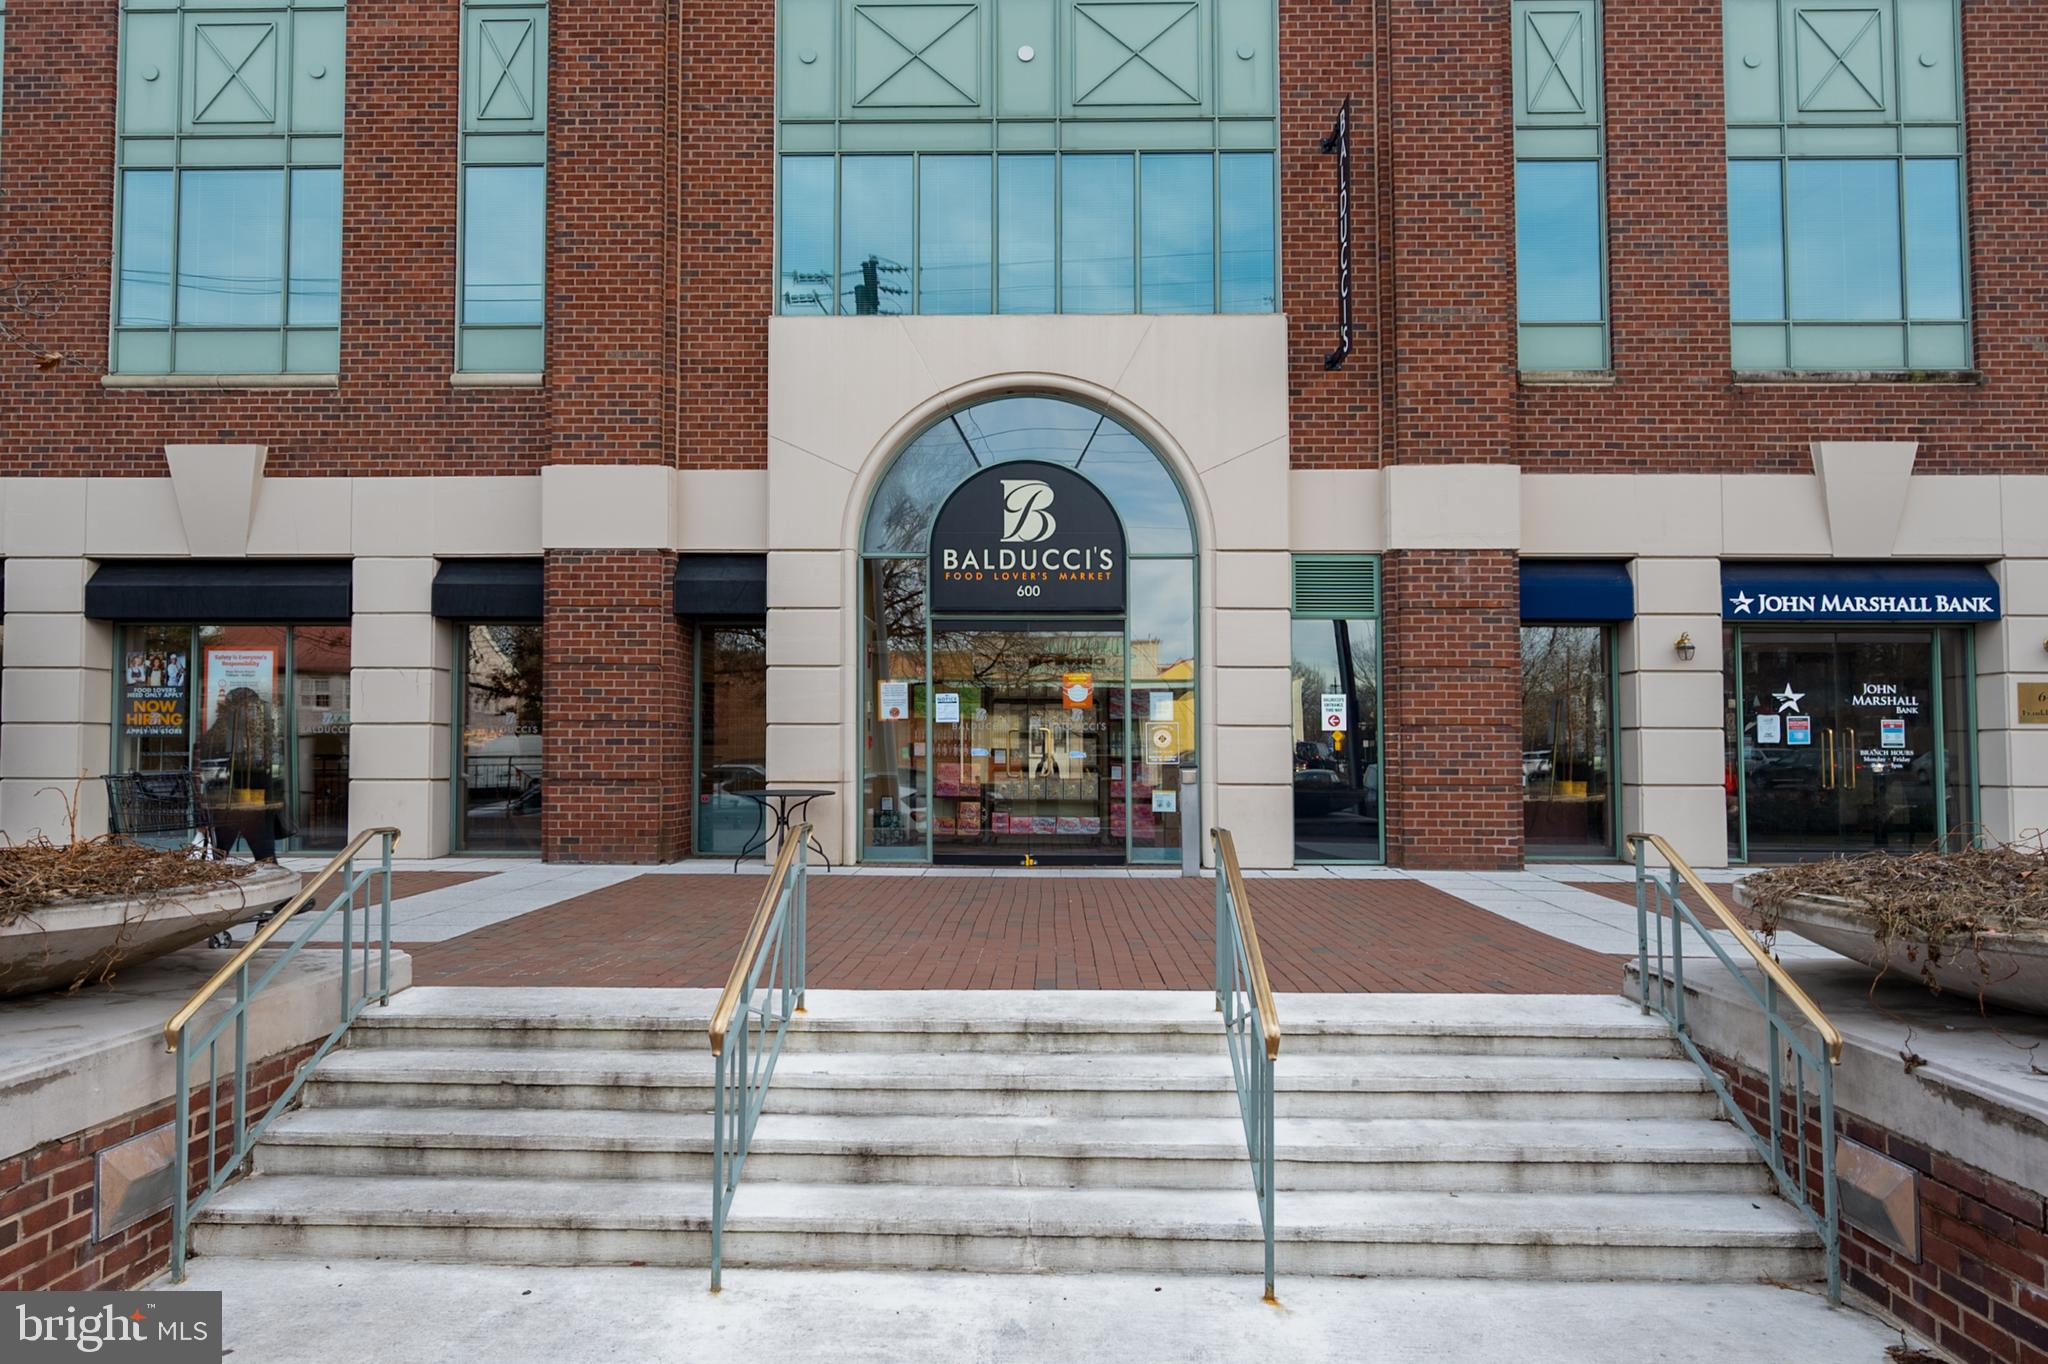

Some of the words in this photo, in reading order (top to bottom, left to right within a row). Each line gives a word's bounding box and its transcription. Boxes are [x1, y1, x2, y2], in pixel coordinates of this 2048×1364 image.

[943, 546, 1114, 570] BALDUCCI'S
[944, 571, 984, 580] FOOD
[993, 571, 1048, 580] LOVER'S
[1058, 571, 1112, 580] MARKET
[1016, 585, 1040, 597] 600
[133, 700, 177, 713] NOW
